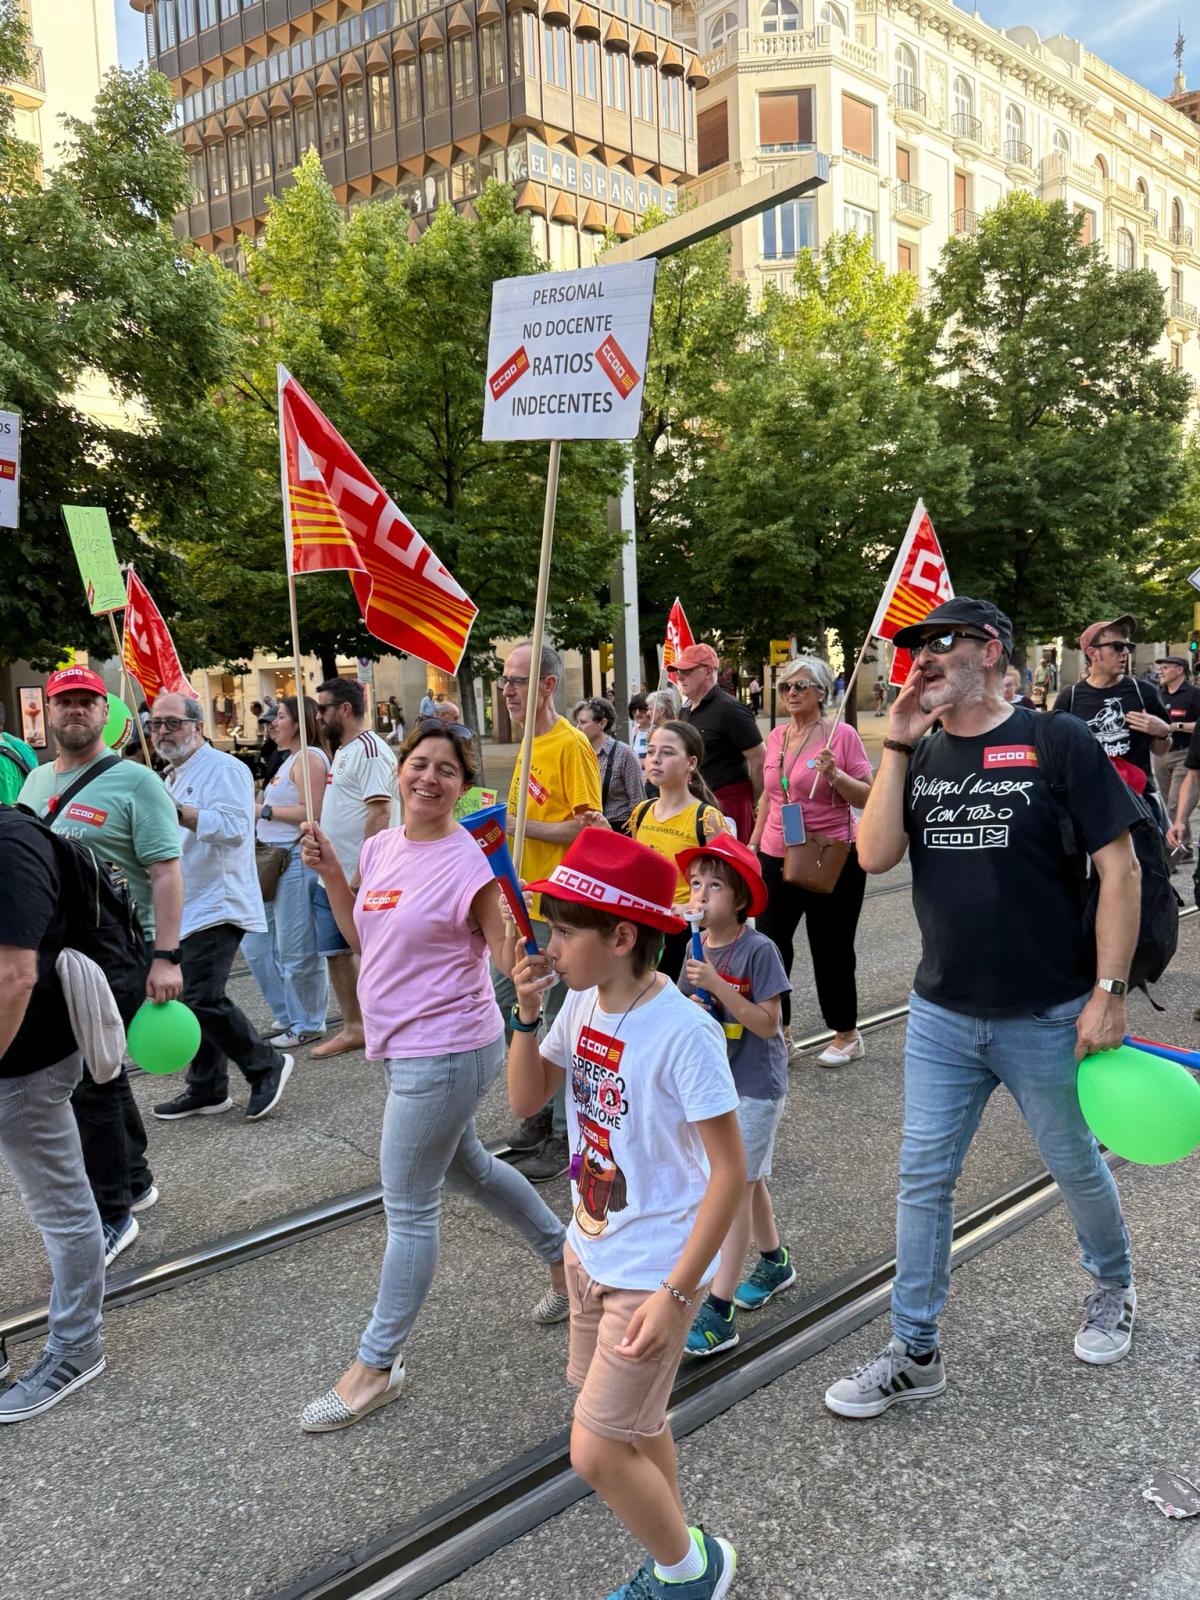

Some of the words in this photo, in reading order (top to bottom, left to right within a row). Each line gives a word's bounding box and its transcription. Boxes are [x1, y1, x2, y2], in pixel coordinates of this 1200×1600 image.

[531, 153, 548, 174] EL
[532, 281, 605, 306] PERSONAL
[523, 322, 542, 340] NO
[545, 314, 613, 337] DOCENTE
[532, 352, 594, 376] RATIOS
[601, 343, 626, 378] CCOO
[492, 363, 518, 392] CCOO
[512, 391, 613, 416] INDECENTES
[54, 668, 83, 682] CCOO
[988, 751, 1024, 762] CCOO
[969, 779, 1034, 806] ACABAR
[69, 807, 95, 819] CCOO
[925, 804, 965, 823] CON
[966, 804, 1013, 821] TODO
[932, 833, 973, 844] CCOO
[554, 870, 606, 900] CCOO
[366, 896, 391, 905] CCOO
[580, 1037, 608, 1057] CCOO
